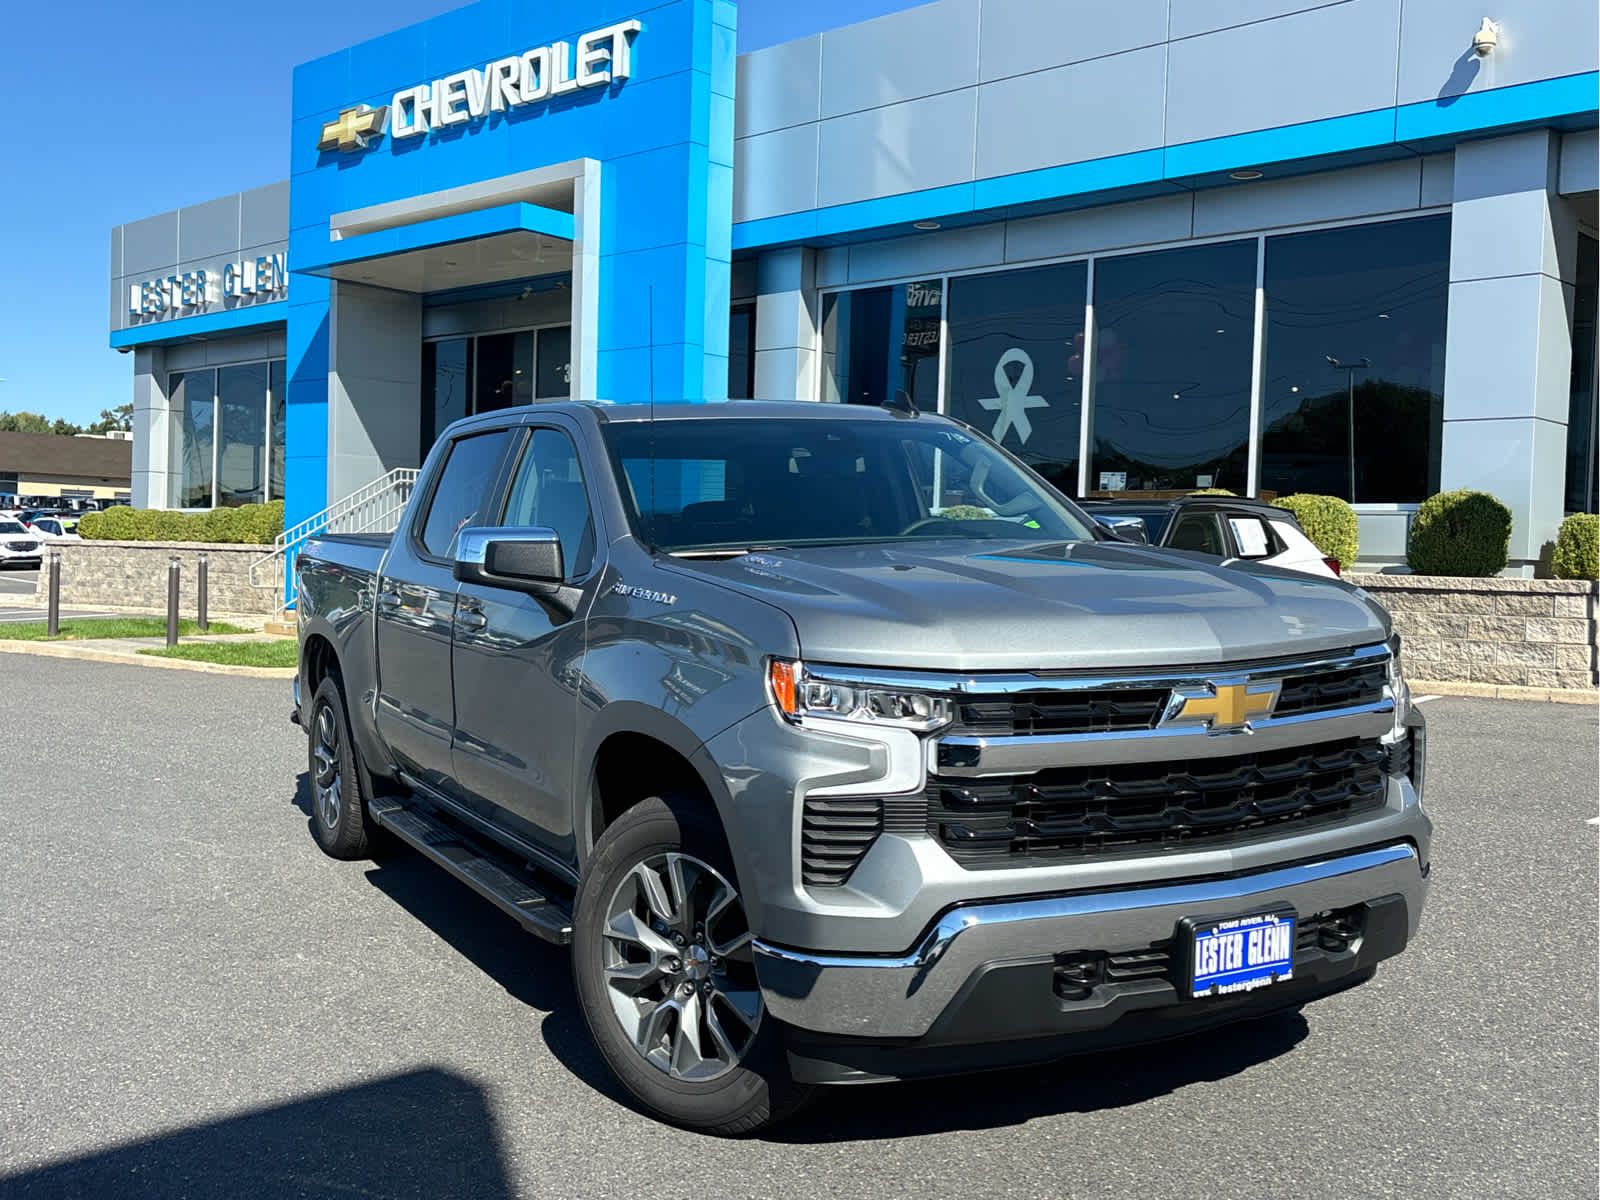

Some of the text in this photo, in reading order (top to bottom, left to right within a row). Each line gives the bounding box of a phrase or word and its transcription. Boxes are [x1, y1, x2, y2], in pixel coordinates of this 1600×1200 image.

[391, 19, 642, 139] CHEVROLET
[129, 253, 288, 314] LESTER GLEN
[1195, 925, 1290, 976] LESTER GLENN
[1218, 976, 1272, 994] lesterglenn
